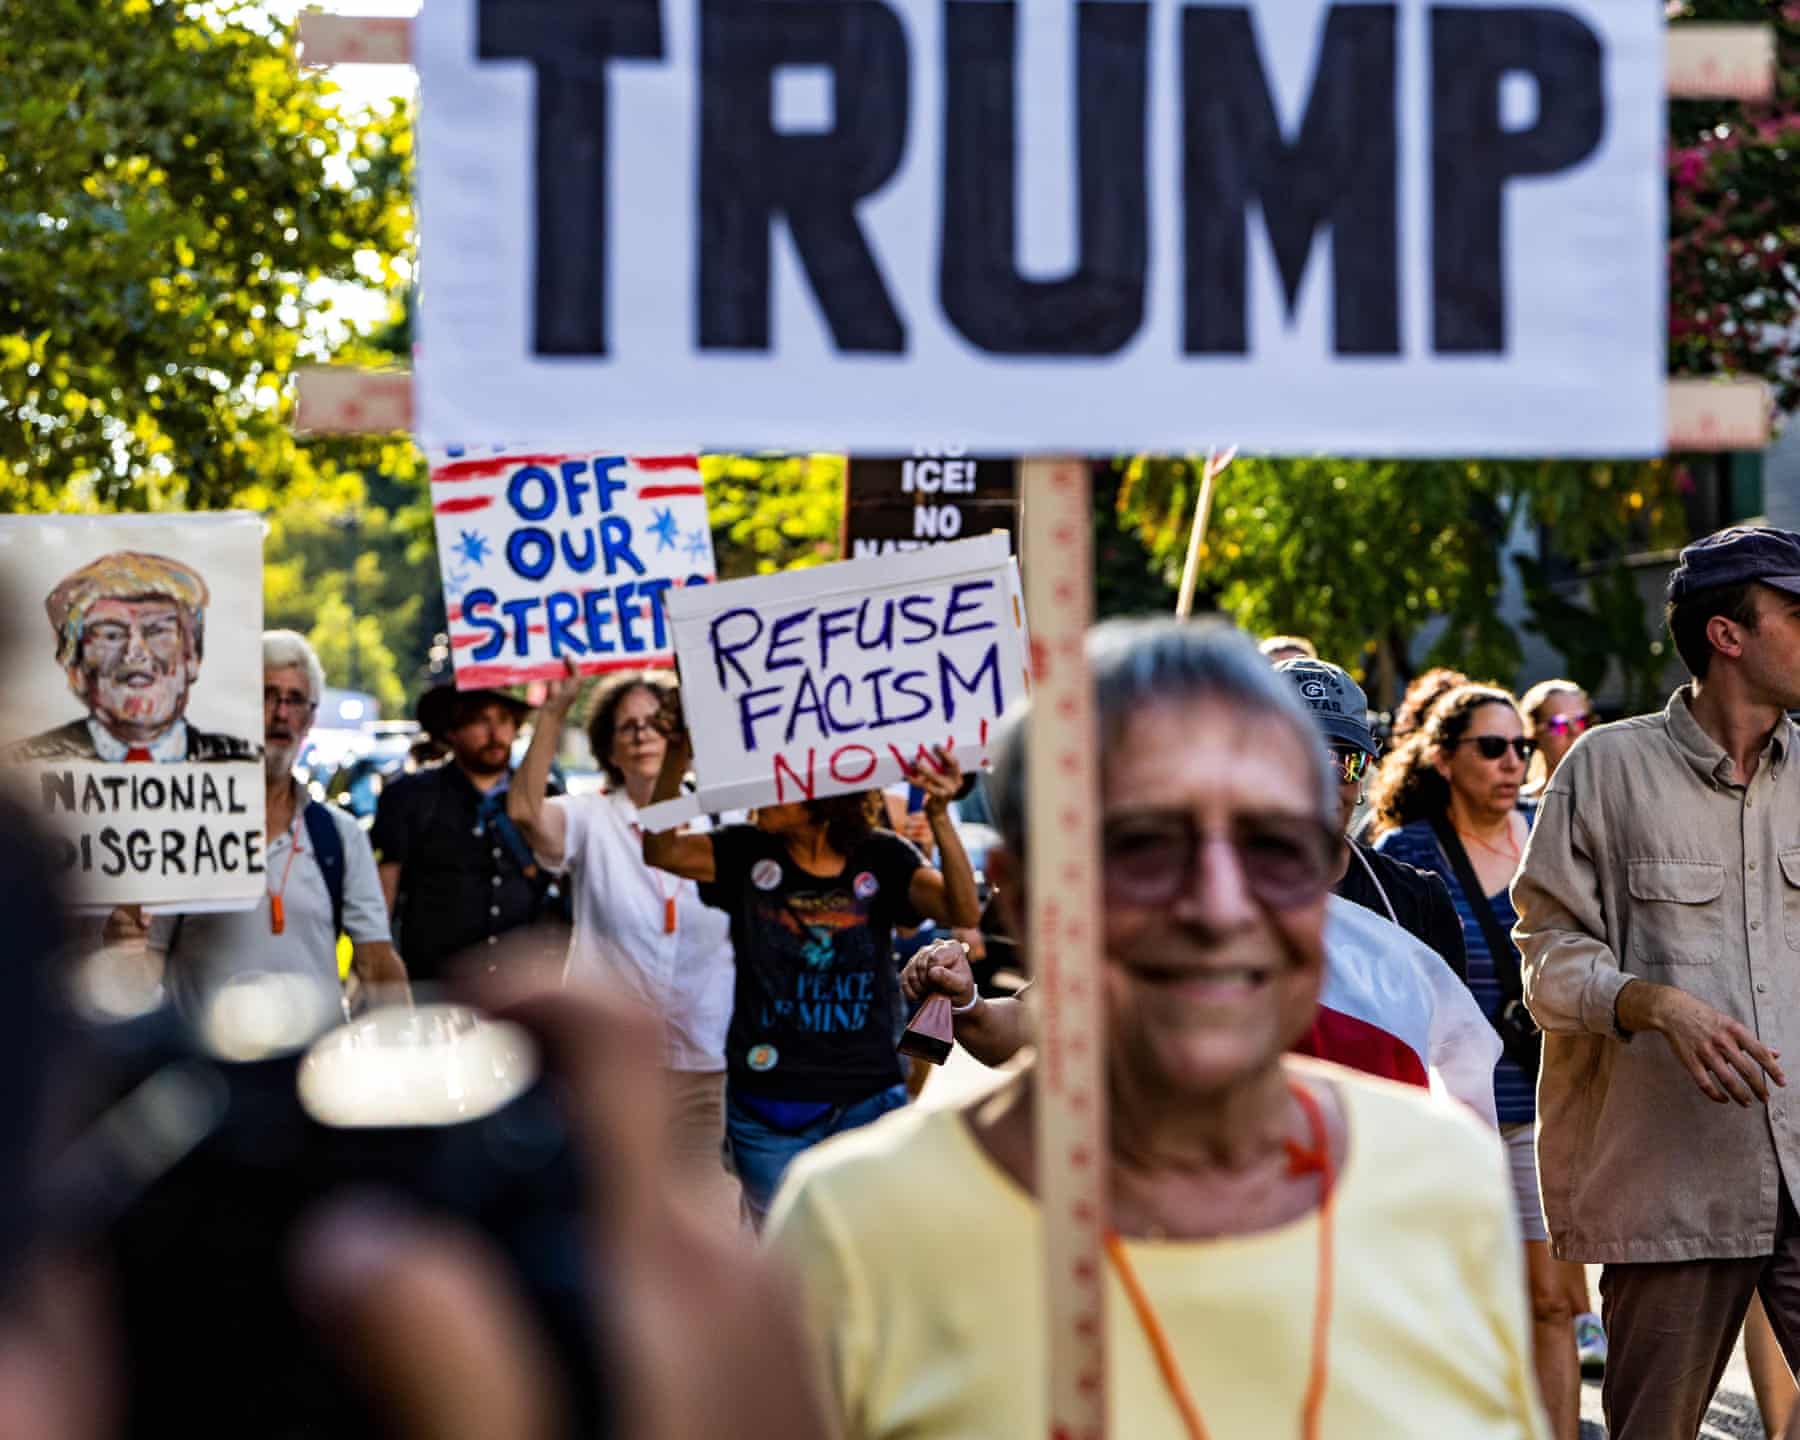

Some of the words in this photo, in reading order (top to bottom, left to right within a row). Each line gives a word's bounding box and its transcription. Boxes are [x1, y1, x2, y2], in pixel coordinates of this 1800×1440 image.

[475, 0, 1610, 361] TRUMP
[507, 456, 627, 520] OFF
[901, 459, 977, 494] ICE!
[505, 516, 646, 581] OUR
[913, 504, 962, 537] NO
[462, 574, 708, 661] STREET
[708, 580, 997, 690] REFUSE
[737, 642, 1003, 752] FACISM
[41, 770, 247, 814] NATIONAL
